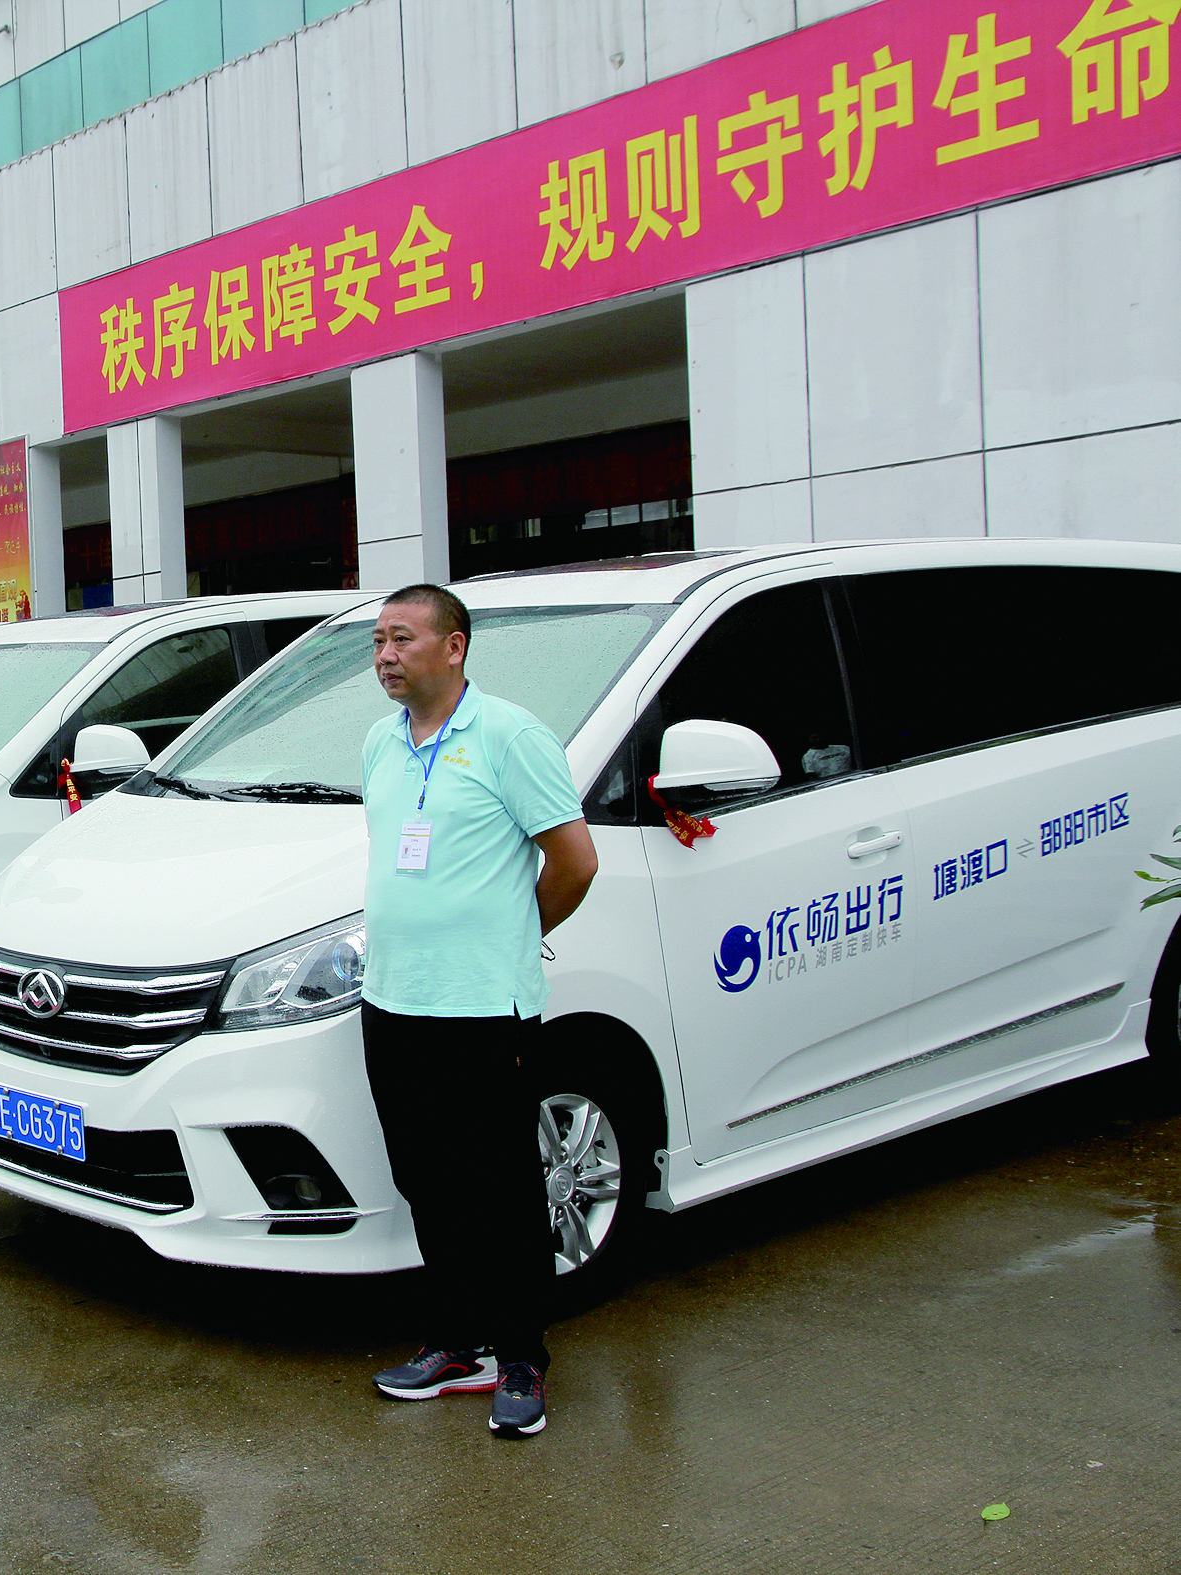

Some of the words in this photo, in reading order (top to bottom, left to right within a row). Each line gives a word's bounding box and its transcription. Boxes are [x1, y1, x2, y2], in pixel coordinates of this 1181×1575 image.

[933, 838, 1009, 901] 塘渡口
[1040, 792, 1129, 857] 邵阳市区
[766, 874, 903, 961] 依畅出行
[768, 953, 807, 984] iCPA
[816, 922, 902, 970] 湖南定制快车
